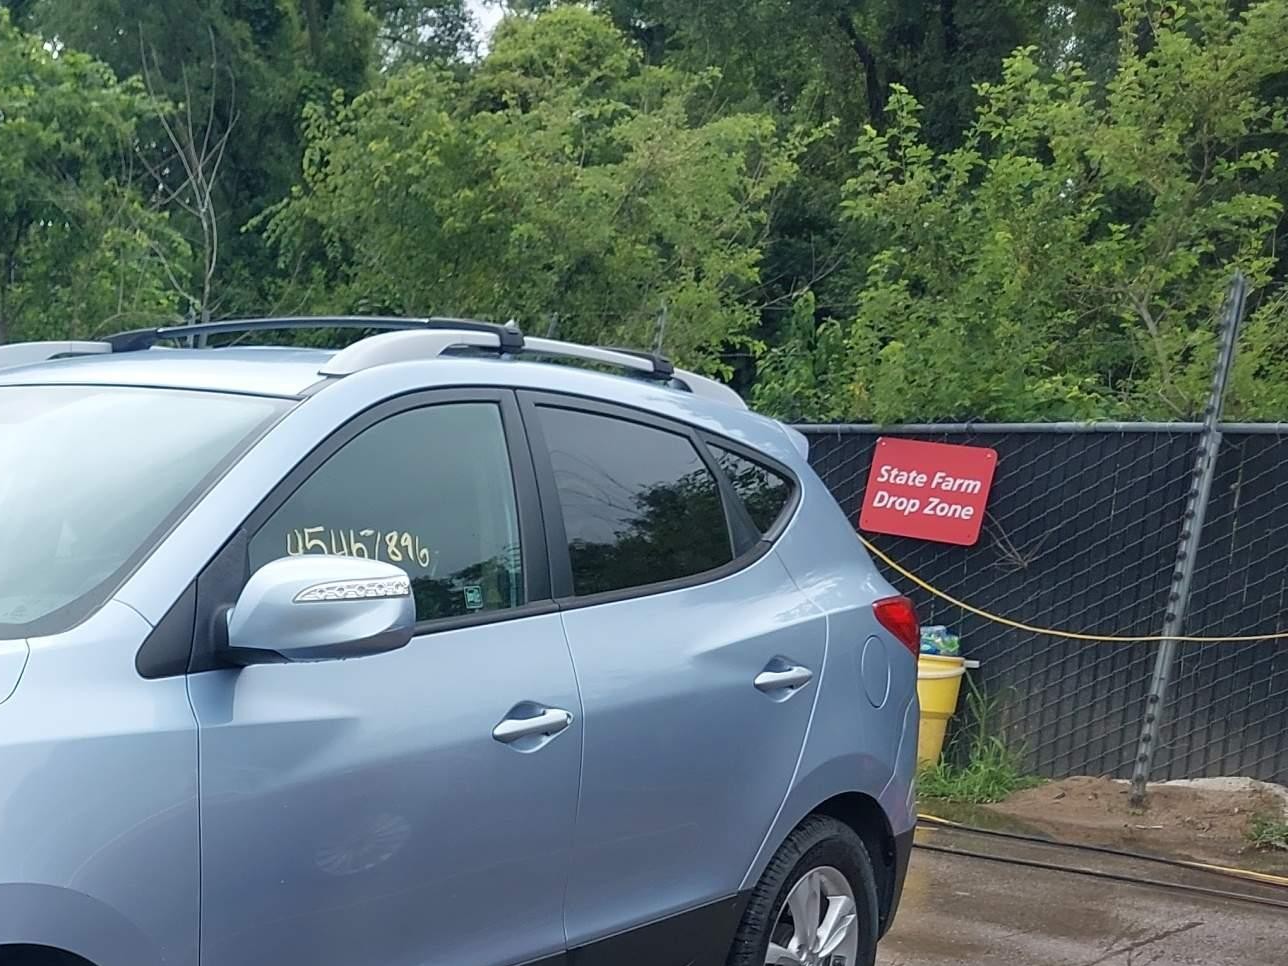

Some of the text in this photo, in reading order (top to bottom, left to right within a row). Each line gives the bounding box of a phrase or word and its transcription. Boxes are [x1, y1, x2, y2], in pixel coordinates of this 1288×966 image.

[877, 465, 982, 494] State Farm
[872, 491, 975, 520] Drop Zone
[286, 525, 430, 568] 45467896
